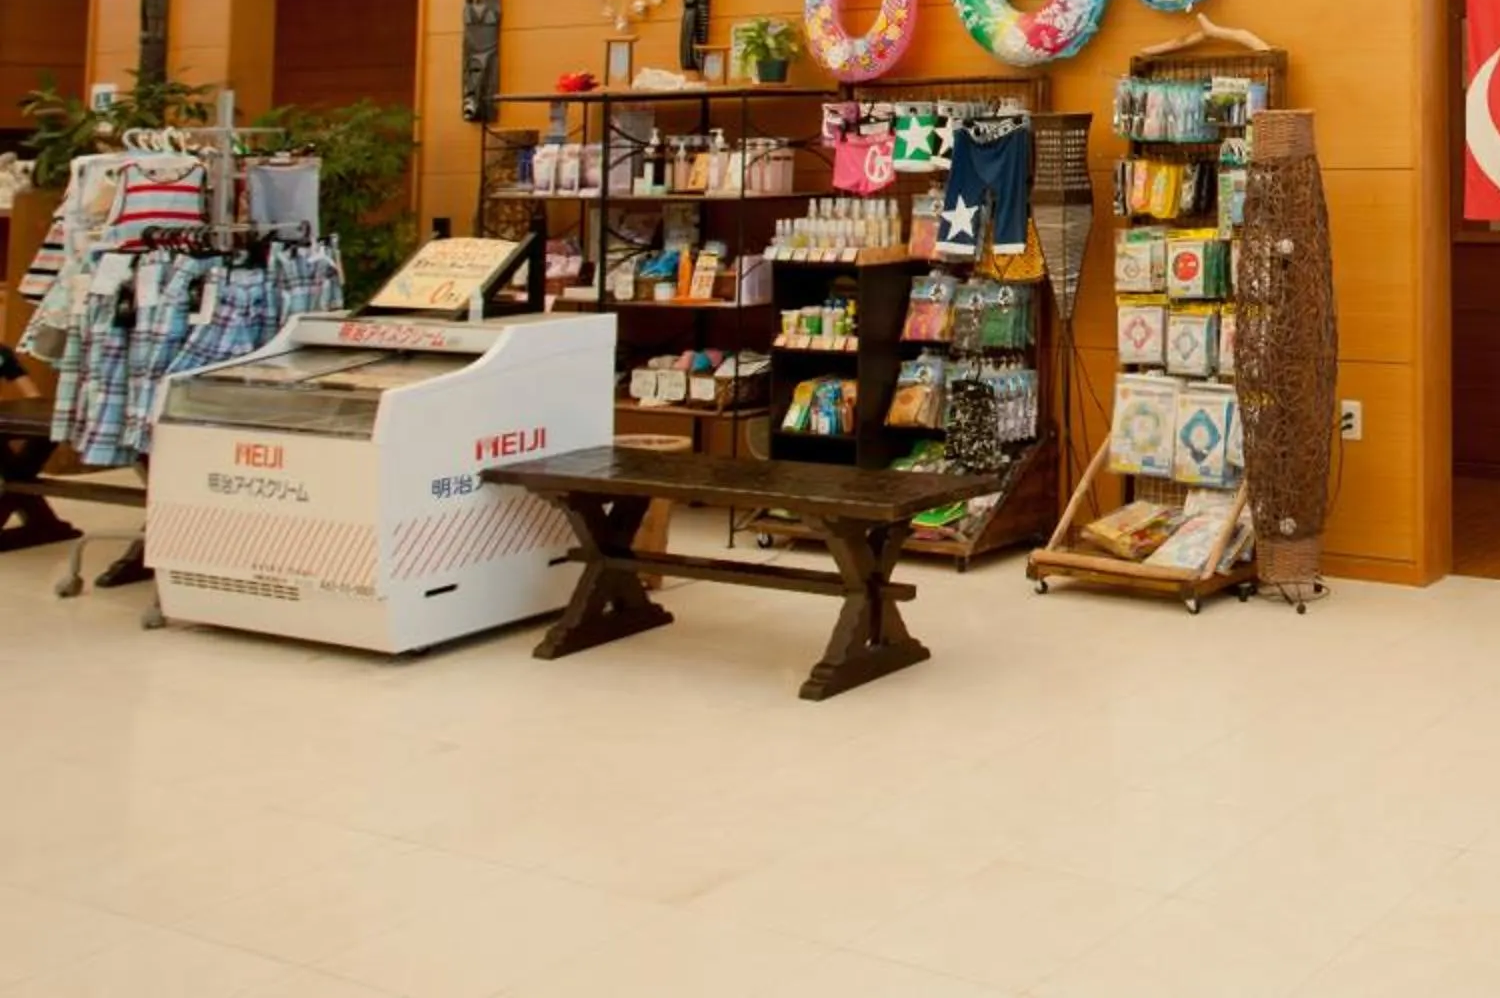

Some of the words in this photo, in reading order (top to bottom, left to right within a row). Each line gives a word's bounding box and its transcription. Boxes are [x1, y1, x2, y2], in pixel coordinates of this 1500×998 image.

[234, 442, 284, 470] MEIJI
[475, 427, 546, 461] MEIJI
[208, 473, 310, 503] 明治アイスクリーム
